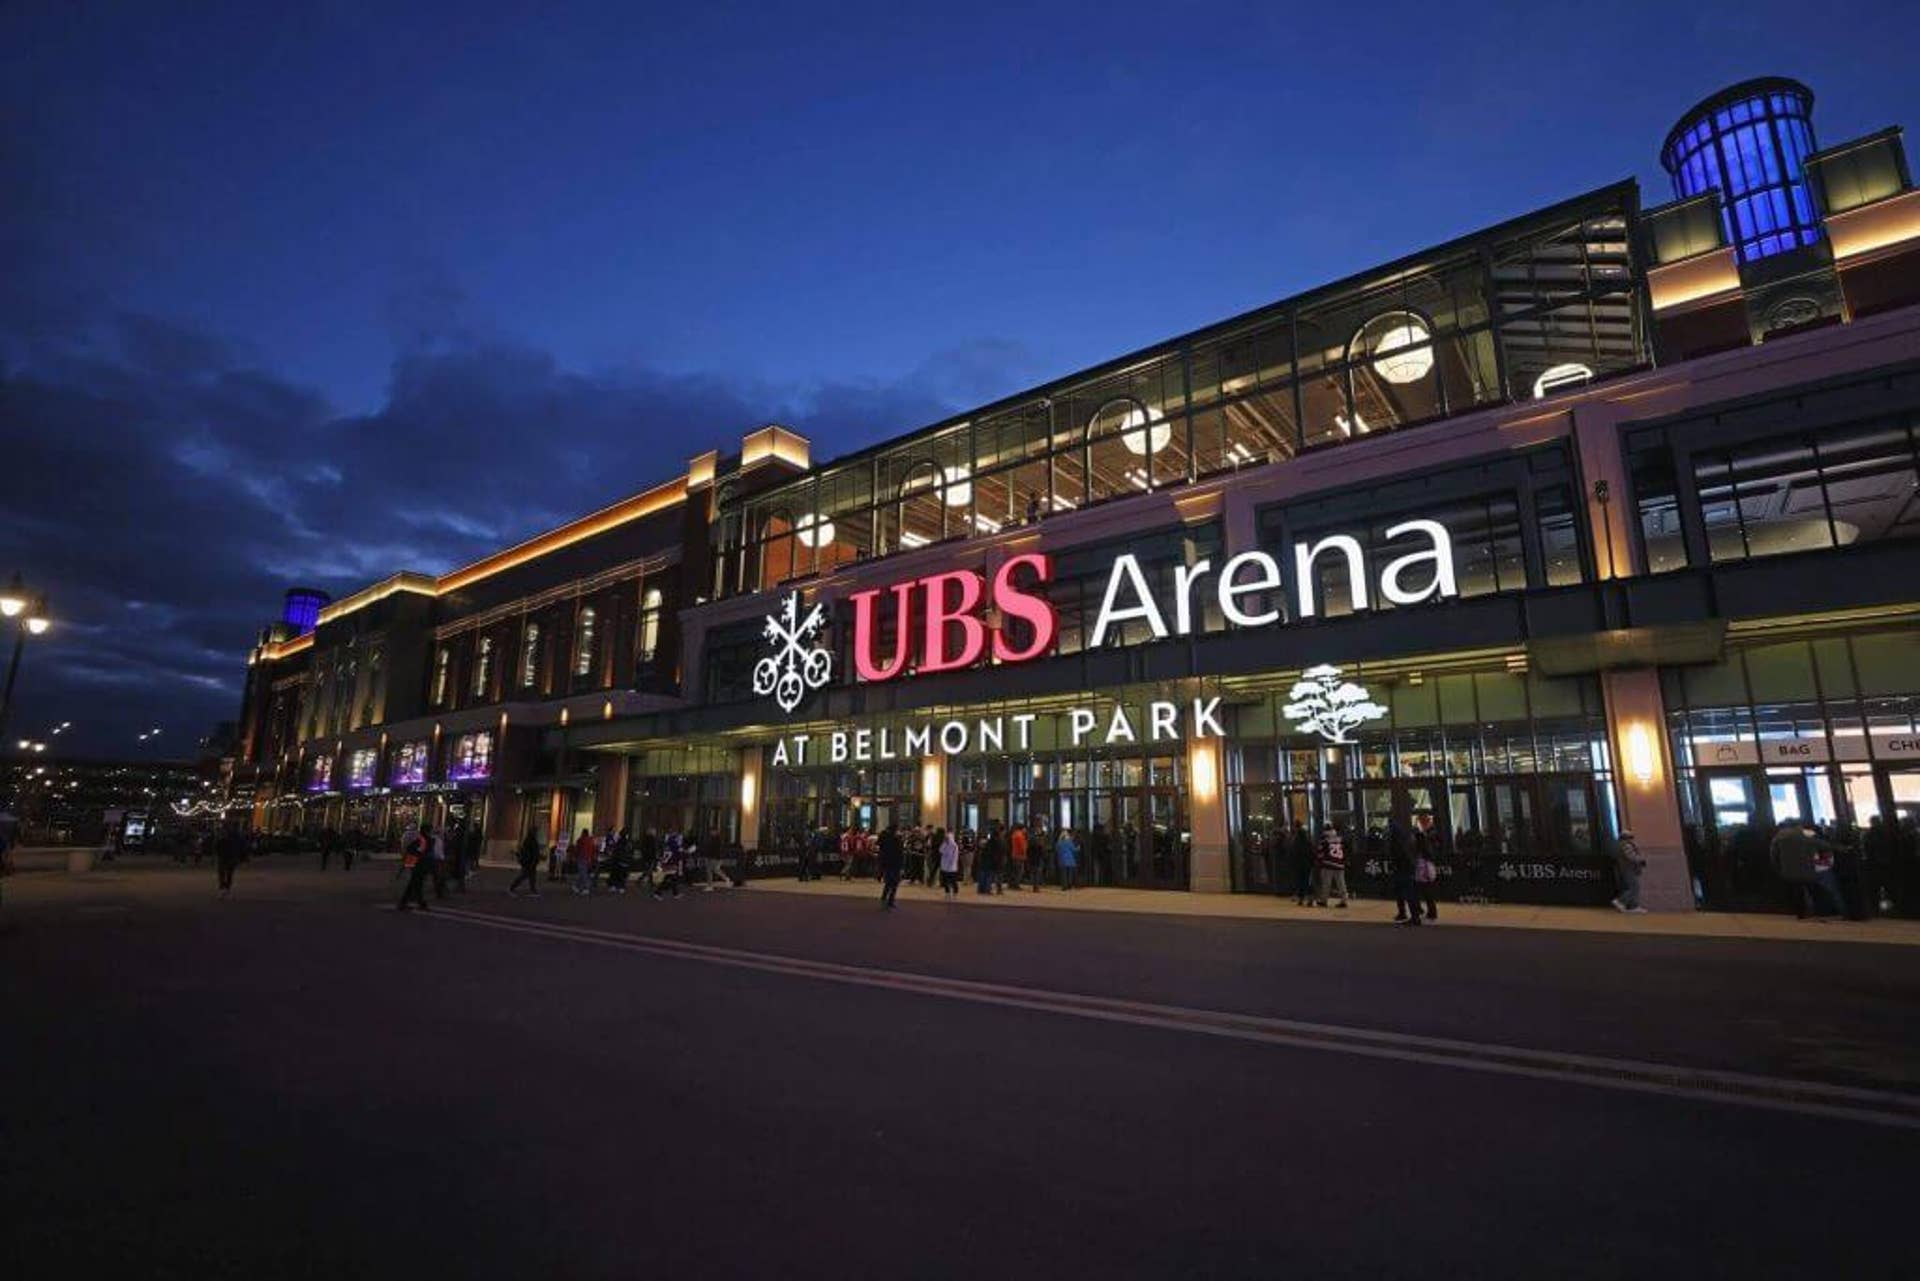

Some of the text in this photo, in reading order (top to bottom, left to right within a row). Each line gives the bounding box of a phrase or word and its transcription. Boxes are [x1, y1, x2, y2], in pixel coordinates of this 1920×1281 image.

[849, 518, 1457, 683] UBS Arena
[772, 696, 1226, 766] AT BELMONT PARK
[1778, 744, 1810, 756] BAG
[1518, 863, 1556, 879] UBS
